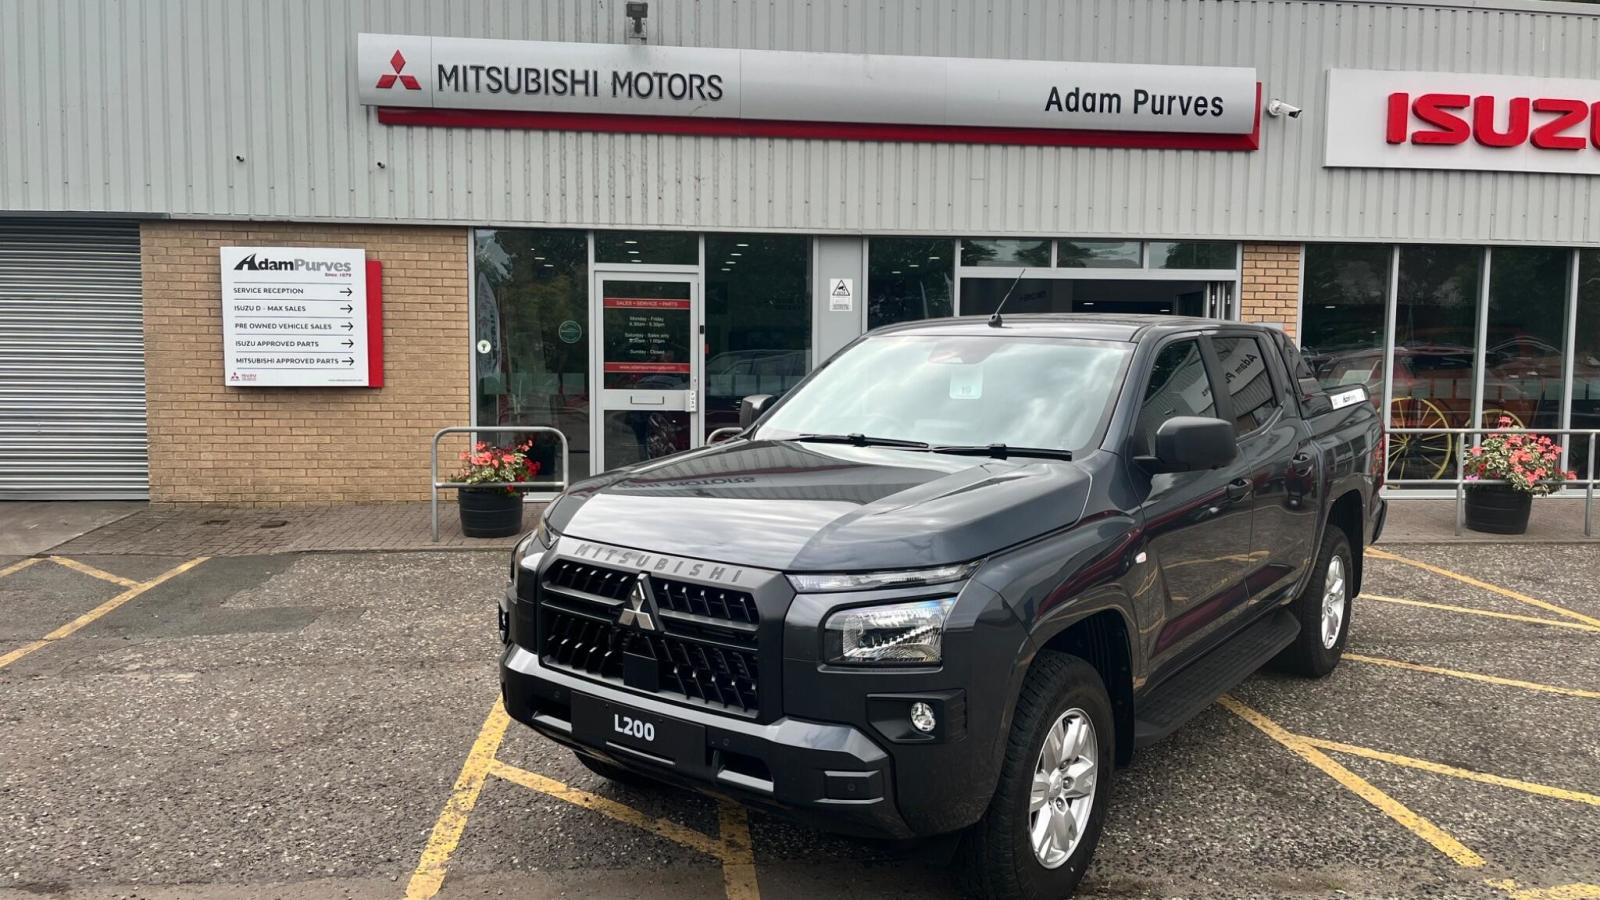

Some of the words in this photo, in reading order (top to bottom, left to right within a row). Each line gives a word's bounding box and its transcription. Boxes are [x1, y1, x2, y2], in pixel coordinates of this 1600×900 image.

[437, 64, 599, 98] MITSUBISHI
[611, 71, 723, 101] MOTORS
[1044, 86, 1122, 114] Adam
[1133, 89, 1224, 117] Purves
[1386, 92, 1600, 151] ISUZ
[233, 253, 351, 272] AdamPurves
[574, 543, 743, 583] MITSUBISHI
[614, 713, 655, 742] L200
